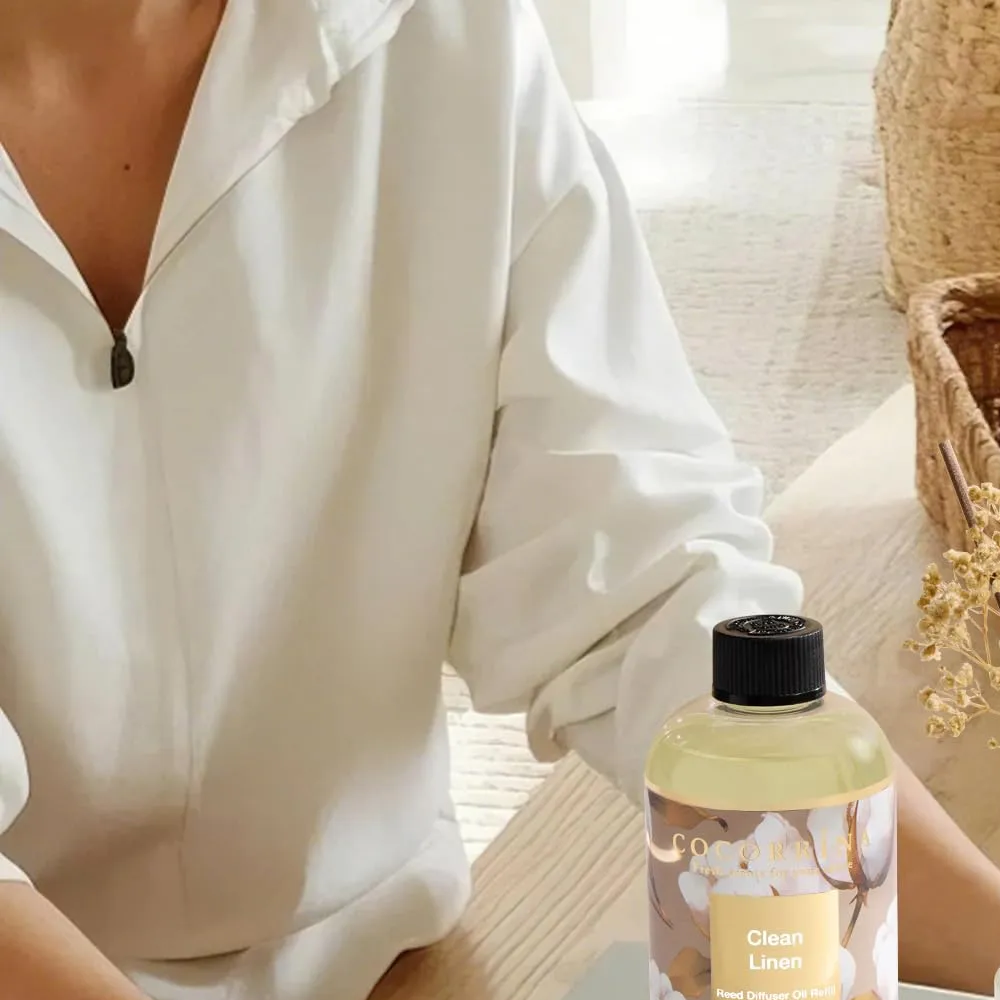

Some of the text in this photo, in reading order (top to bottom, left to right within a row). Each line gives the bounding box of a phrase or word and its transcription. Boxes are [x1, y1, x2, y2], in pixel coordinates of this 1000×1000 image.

[747, 929, 804, 946] Clean
[749, 953, 802, 970] Linen
[716, 984, 836, 1000] Reed Diffuser Oil Refill
